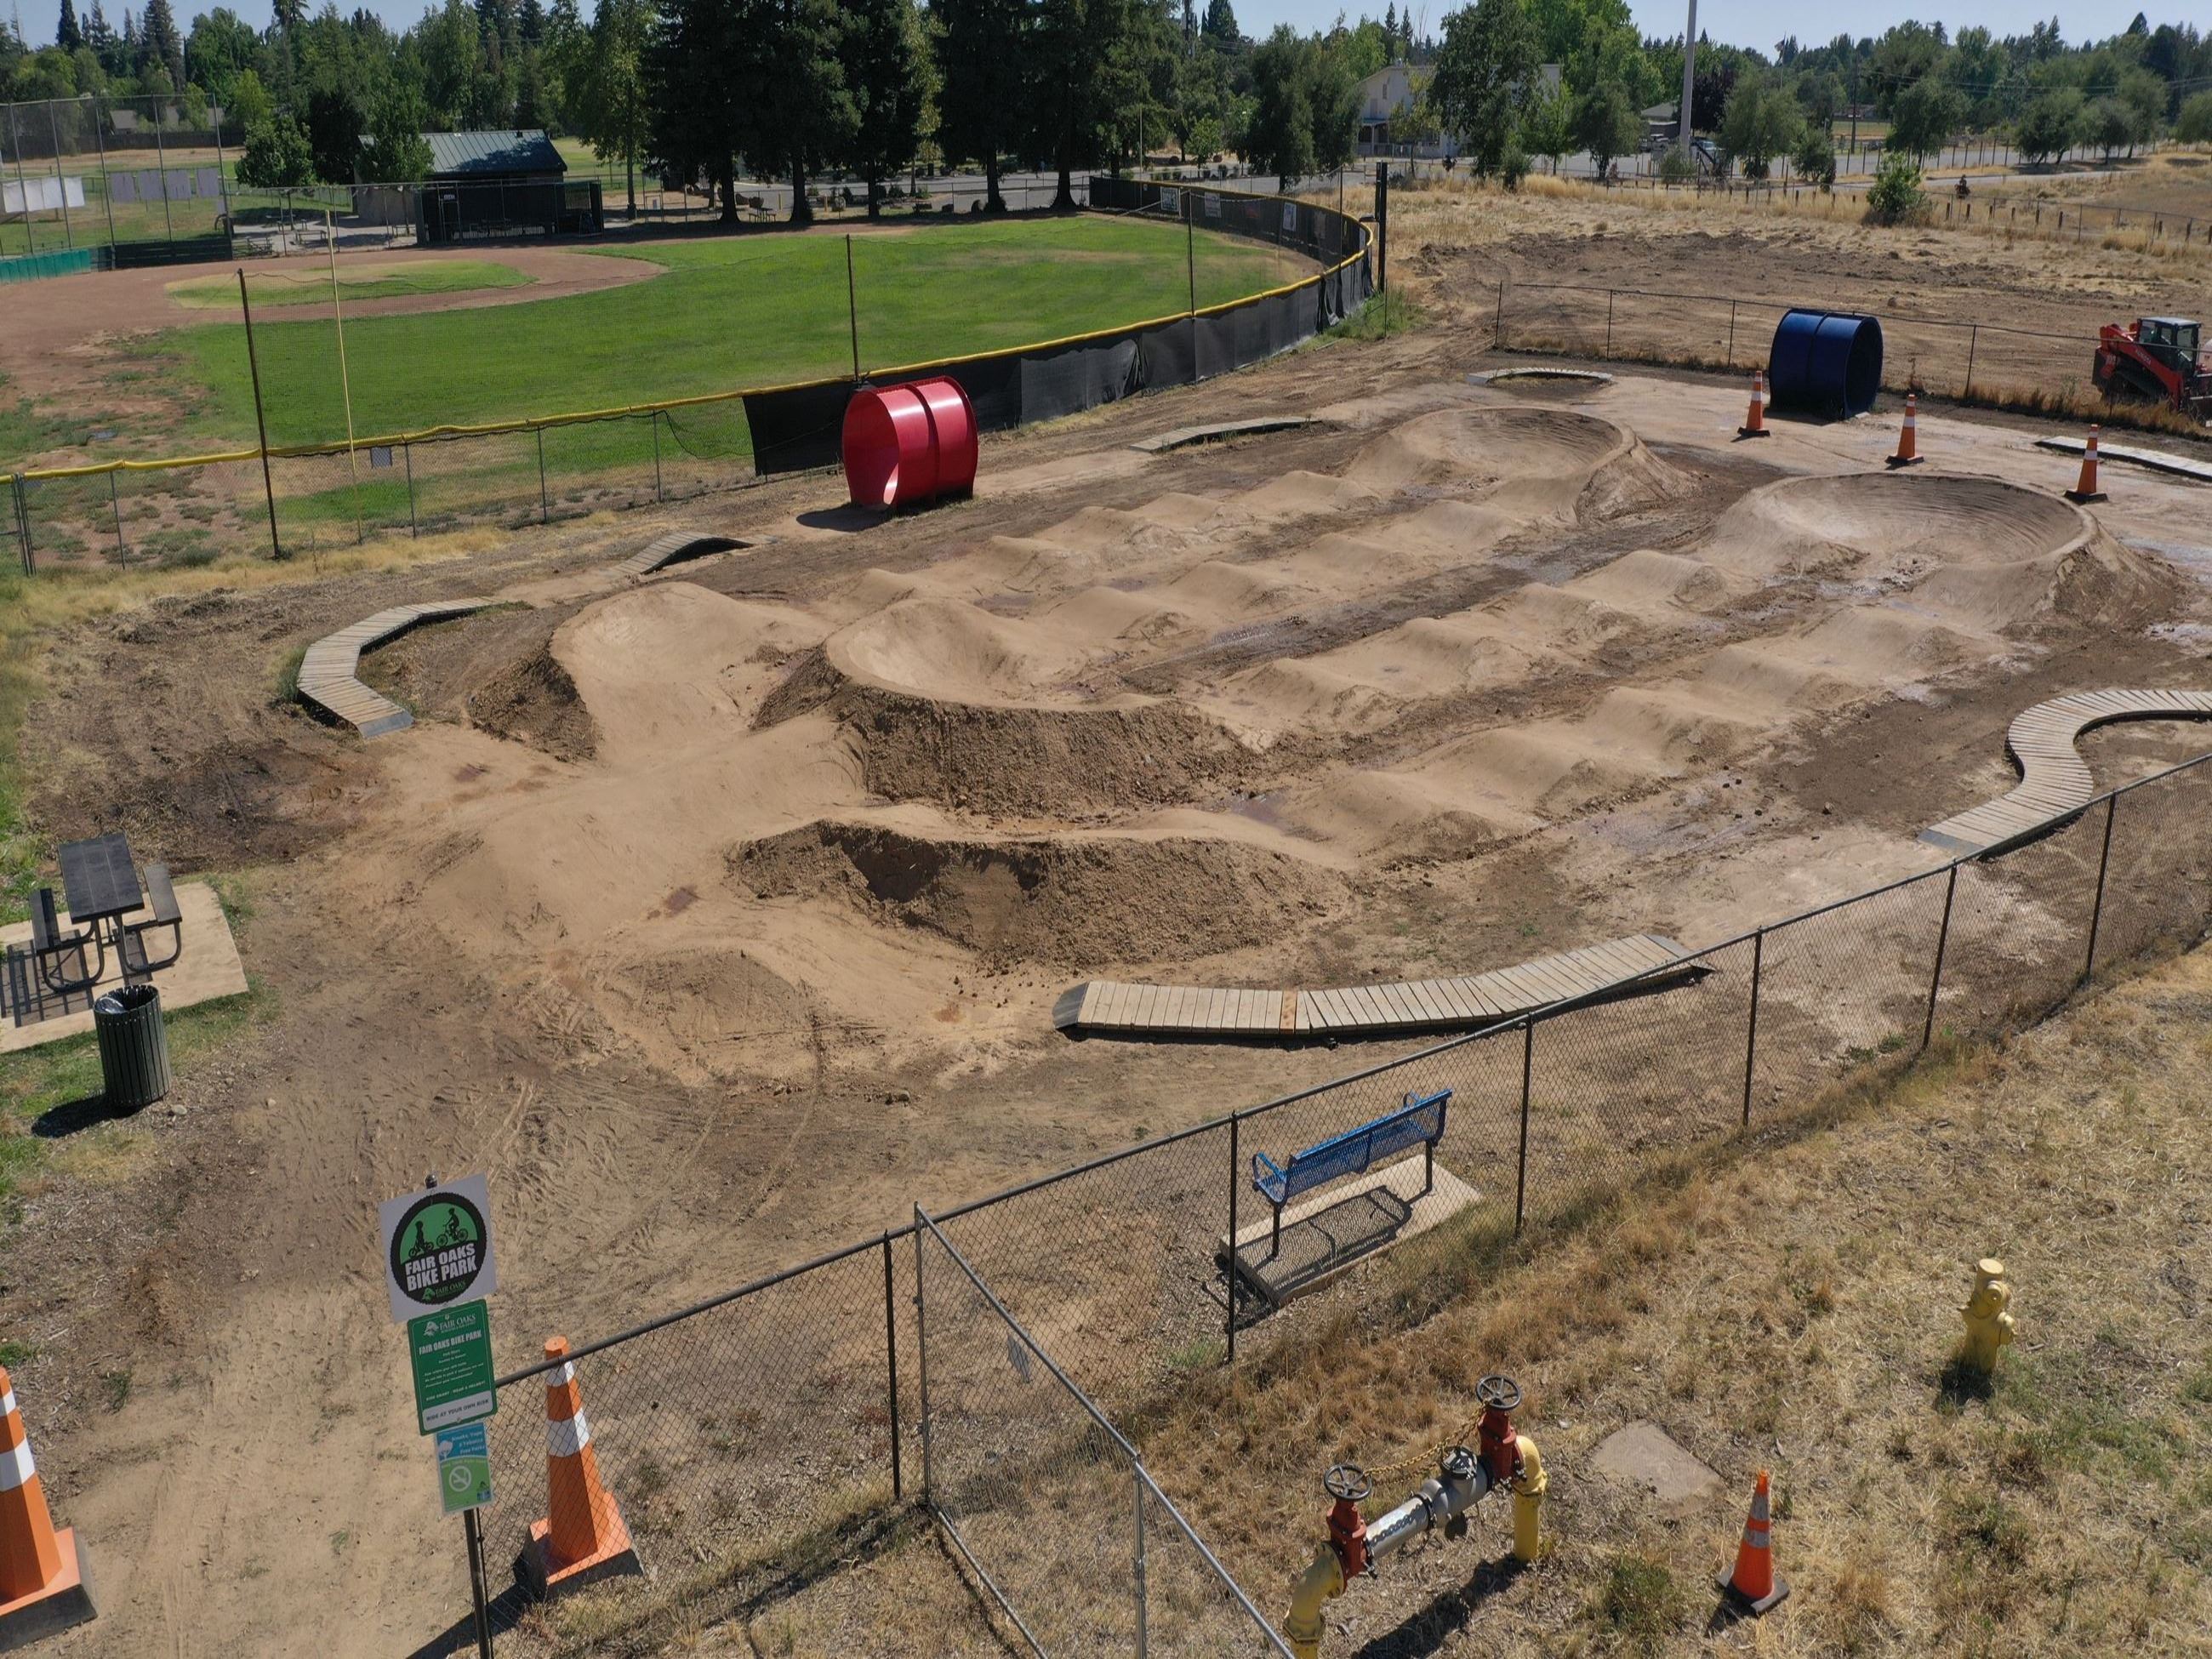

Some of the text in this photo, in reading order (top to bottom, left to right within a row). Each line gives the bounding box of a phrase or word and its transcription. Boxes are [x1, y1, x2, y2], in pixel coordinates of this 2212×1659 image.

[405, 1243, 476, 1275] FAIR OAKS
[407, 1255, 477, 1291] BIKE PARK
[435, 1286, 449, 1297] FAIR
[450, 1280, 466, 1292] OAKS
[439, 1321, 455, 1331] FAIR
[456, 1314, 476, 1326] OAKS
[419, 1330, 482, 1355] FAIR OAKS BIKE PARK
